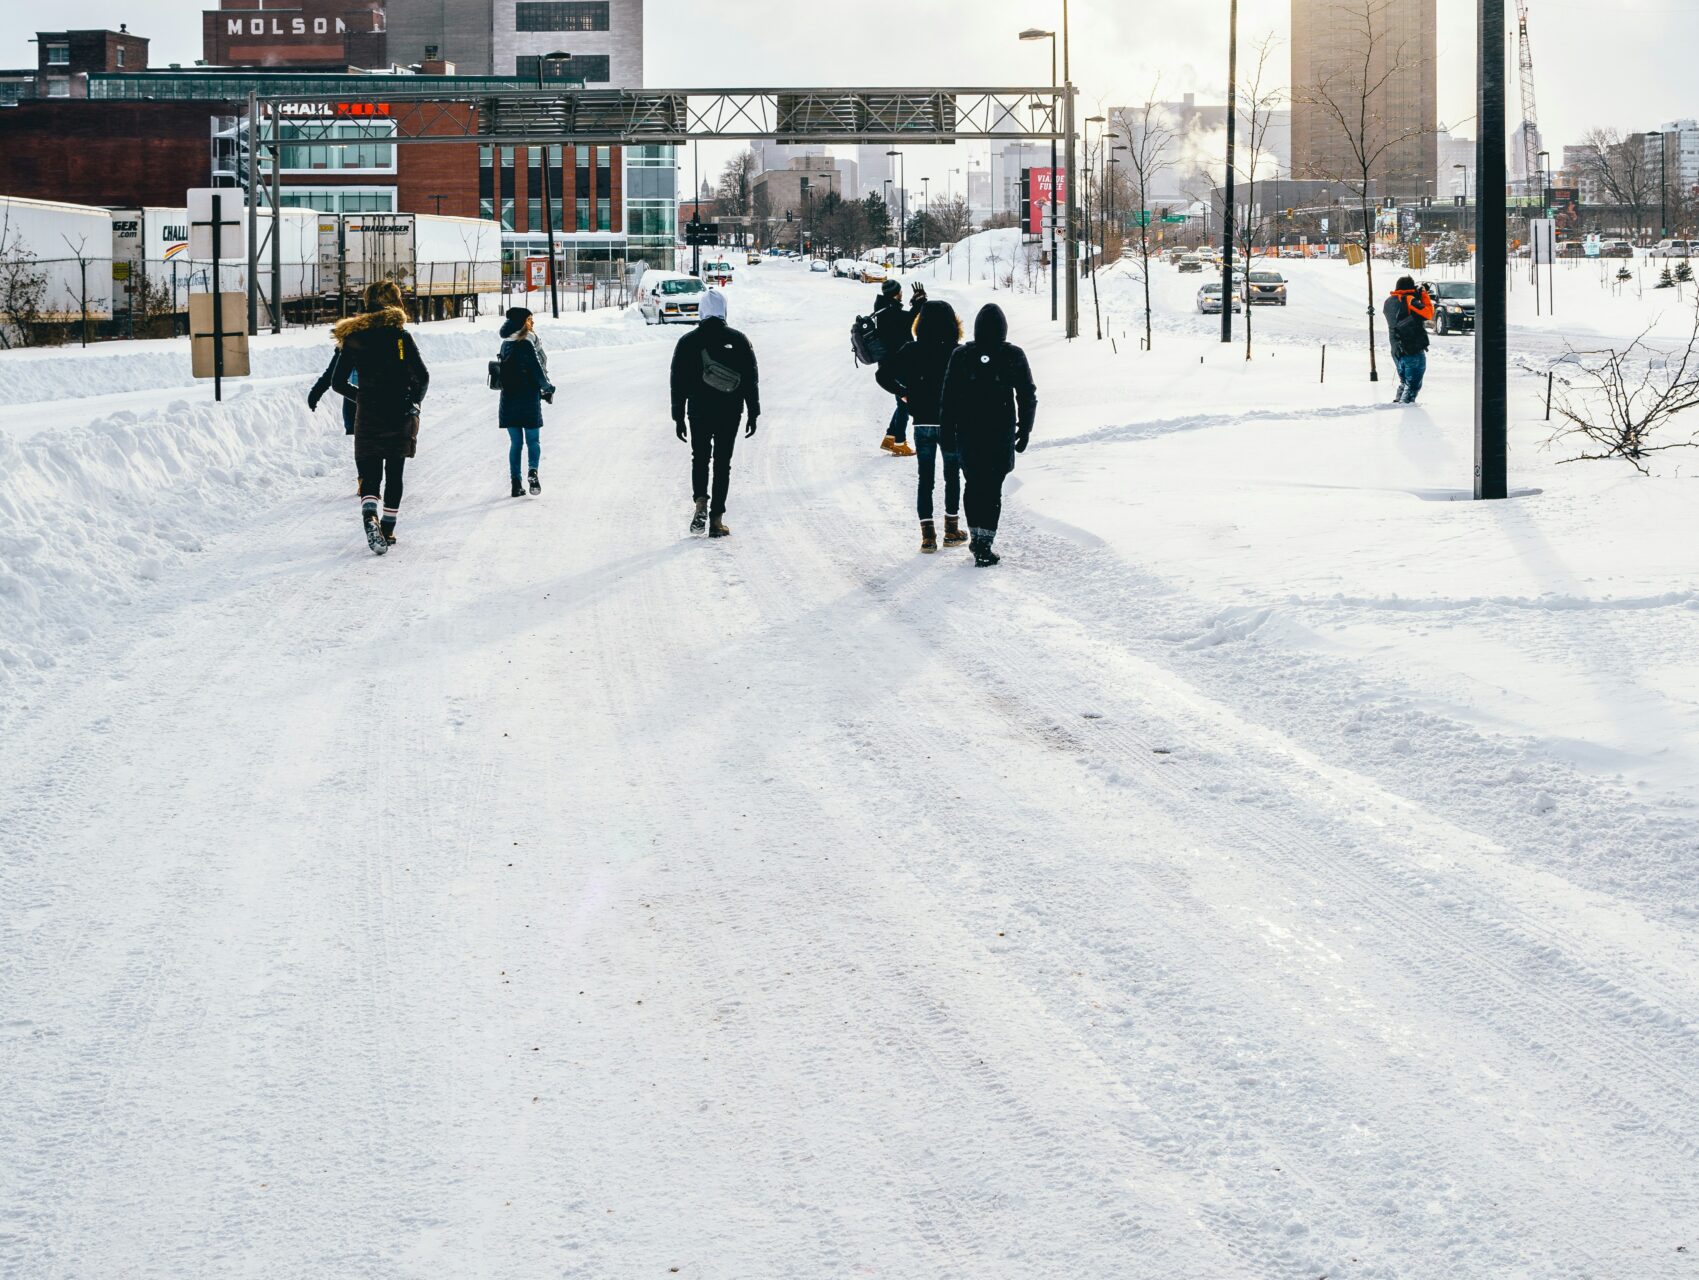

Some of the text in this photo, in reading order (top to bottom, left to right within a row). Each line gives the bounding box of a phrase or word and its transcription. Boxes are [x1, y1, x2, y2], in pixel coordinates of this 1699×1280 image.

[227, 18, 346, 35] MOLSON
[1037, 174, 1064, 182] VIADE
[111, 221, 138, 232] GER
[360, 225, 409, 233] CHALLENGER
[117, 231, 138, 239] .com
